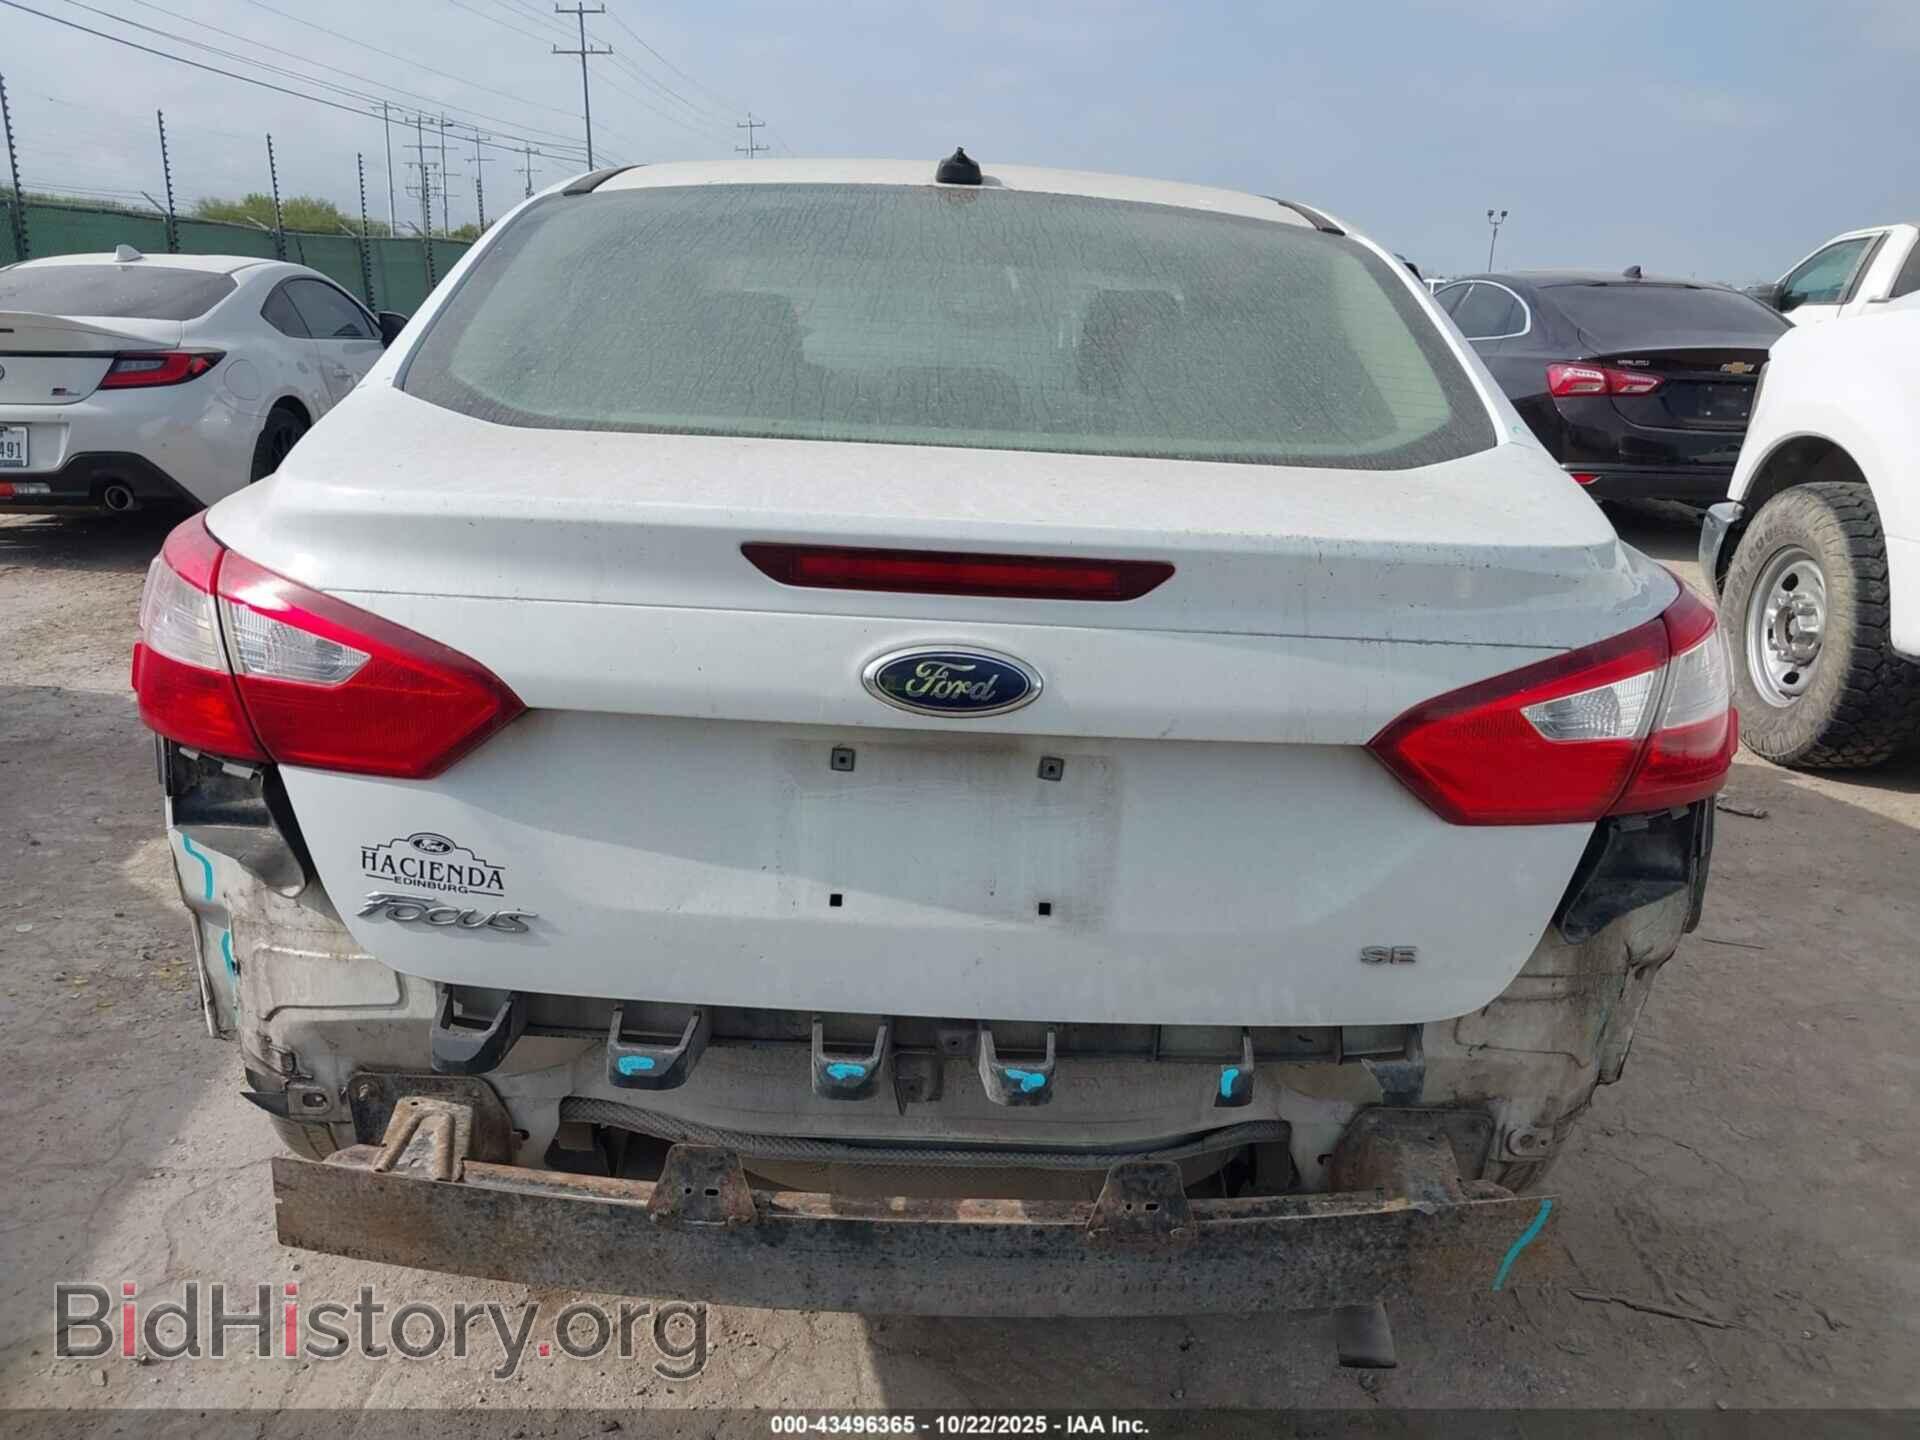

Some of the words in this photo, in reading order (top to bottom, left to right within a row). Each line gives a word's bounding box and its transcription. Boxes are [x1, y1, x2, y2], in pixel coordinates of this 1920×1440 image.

[905, 661, 1000, 701] Ford
[360, 850, 505, 891] HACIENDA
[394, 875, 469, 895] EDINBURG
[1360, 945, 1417, 966] SE
